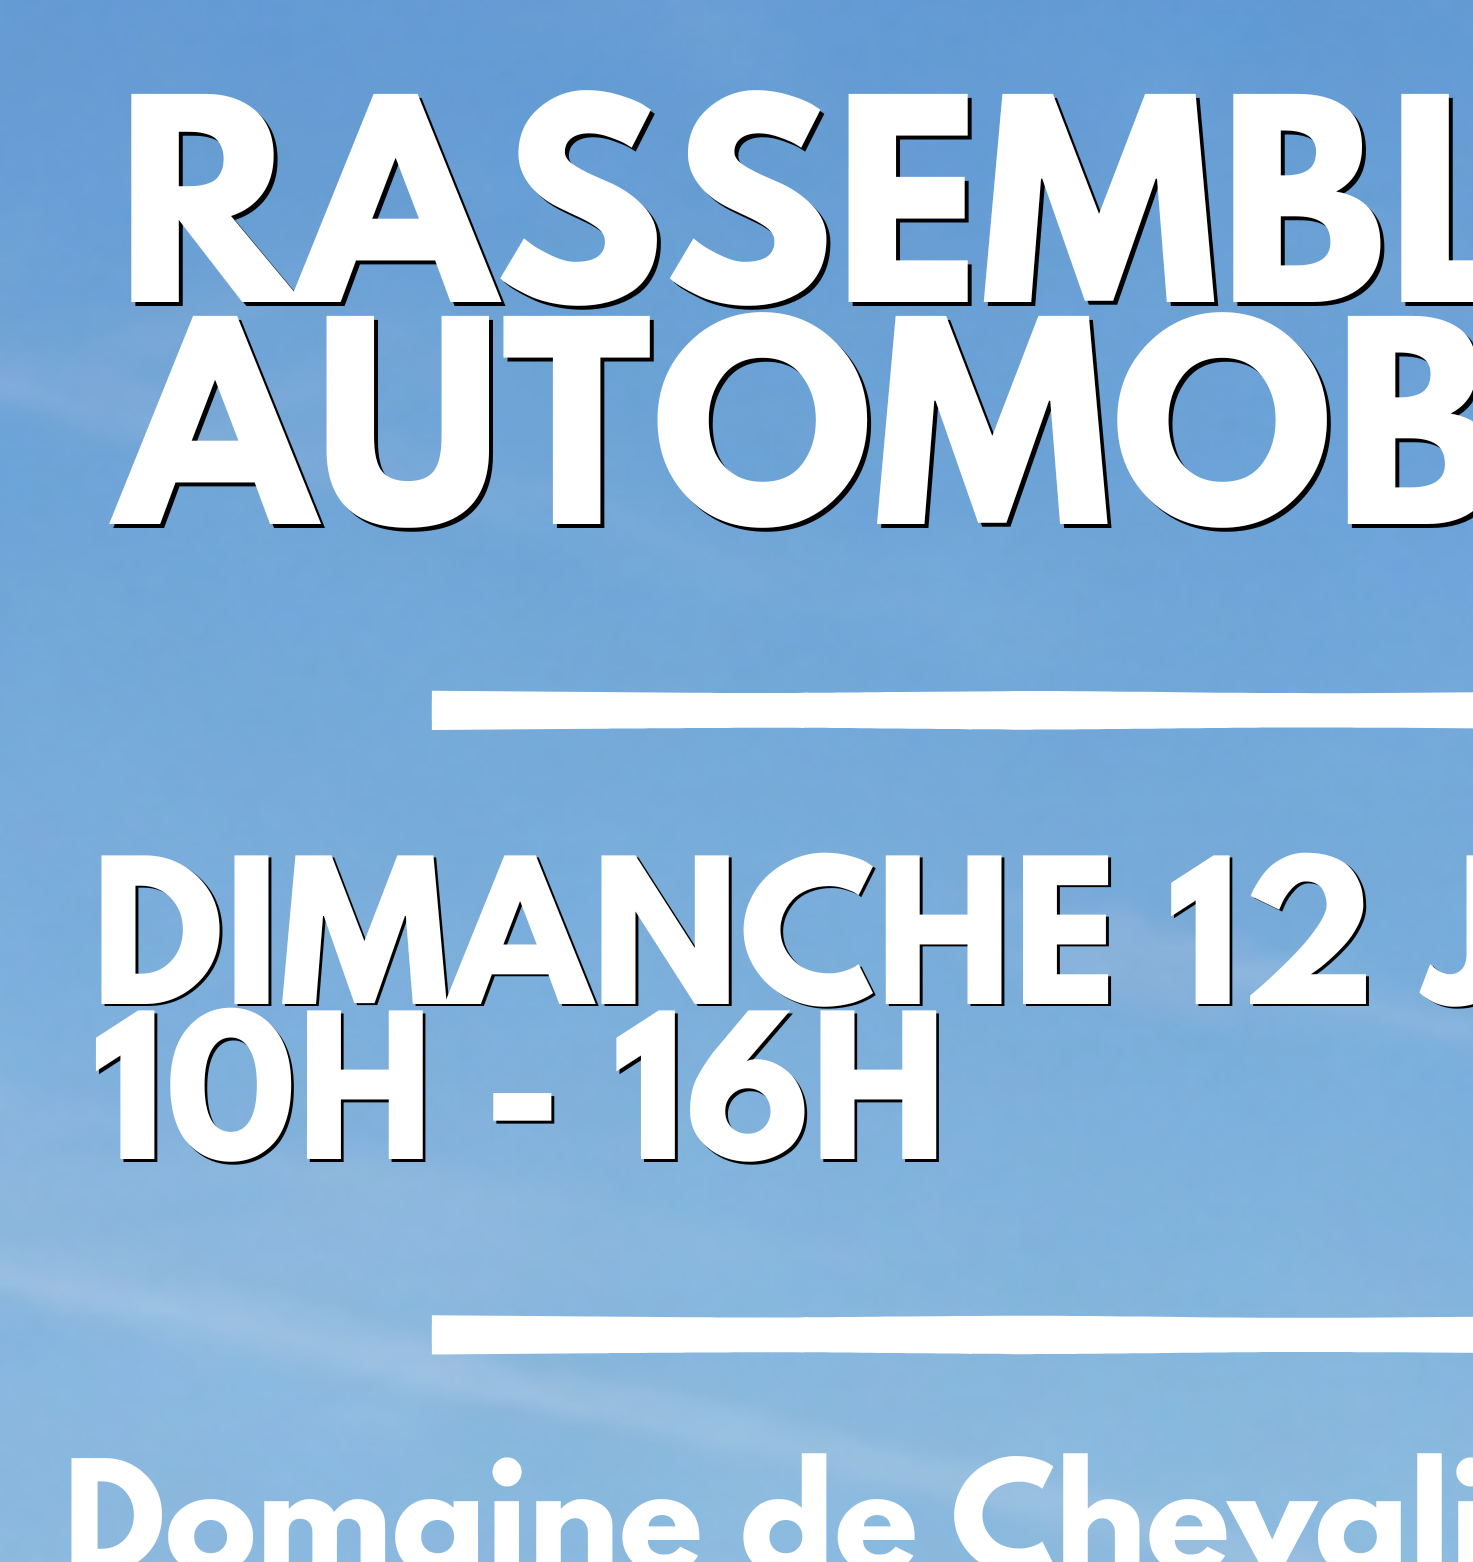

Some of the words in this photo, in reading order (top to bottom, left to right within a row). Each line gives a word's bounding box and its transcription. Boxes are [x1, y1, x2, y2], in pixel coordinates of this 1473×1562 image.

[100, 852, 1111, 1008] DIMANCHE
[1170, 852, 1369, 1007] 12
[95, 1008, 425, 1164] 10H
[492, 1092, 554, 1124] -
[616, 1010, 939, 1164] 16H
